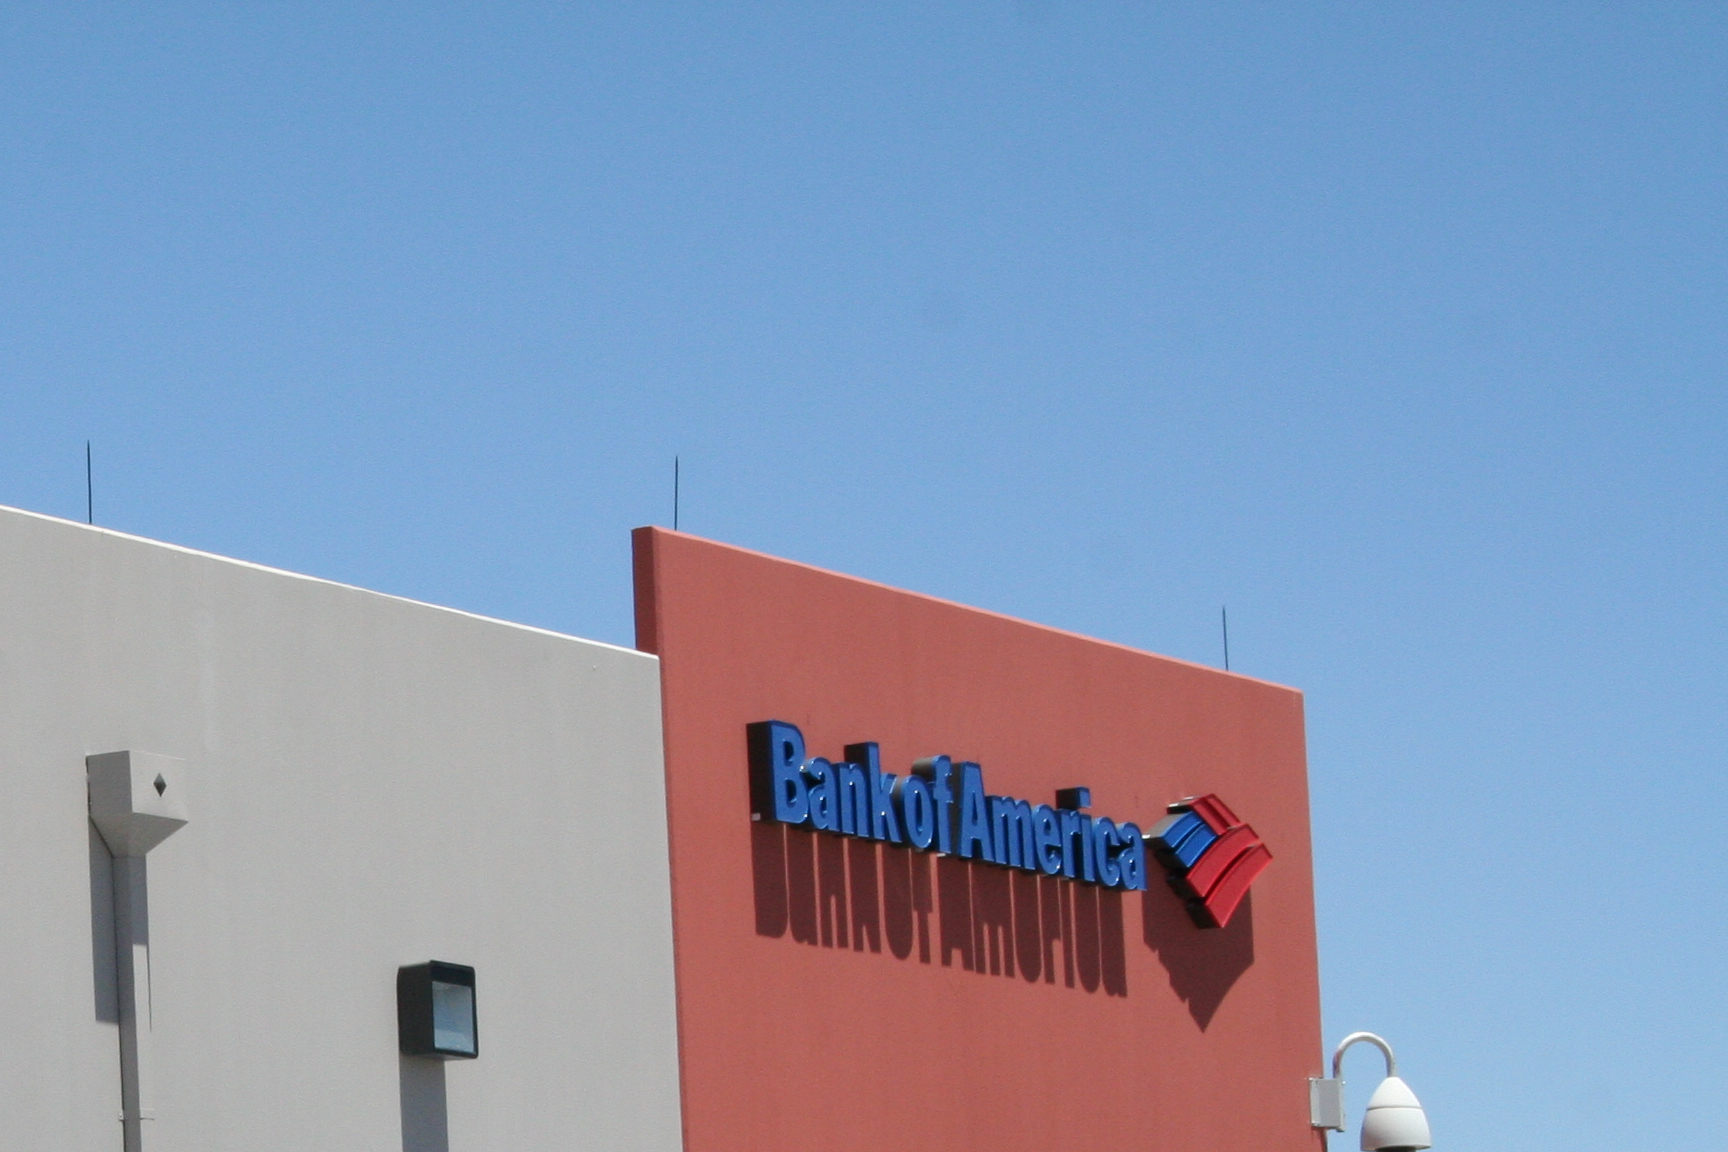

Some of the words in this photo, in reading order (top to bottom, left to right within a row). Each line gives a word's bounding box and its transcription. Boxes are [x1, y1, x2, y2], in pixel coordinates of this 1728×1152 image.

[748, 719, 903, 843] Bank
[902, 755, 954, 857] of
[954, 761, 1147, 892] America
